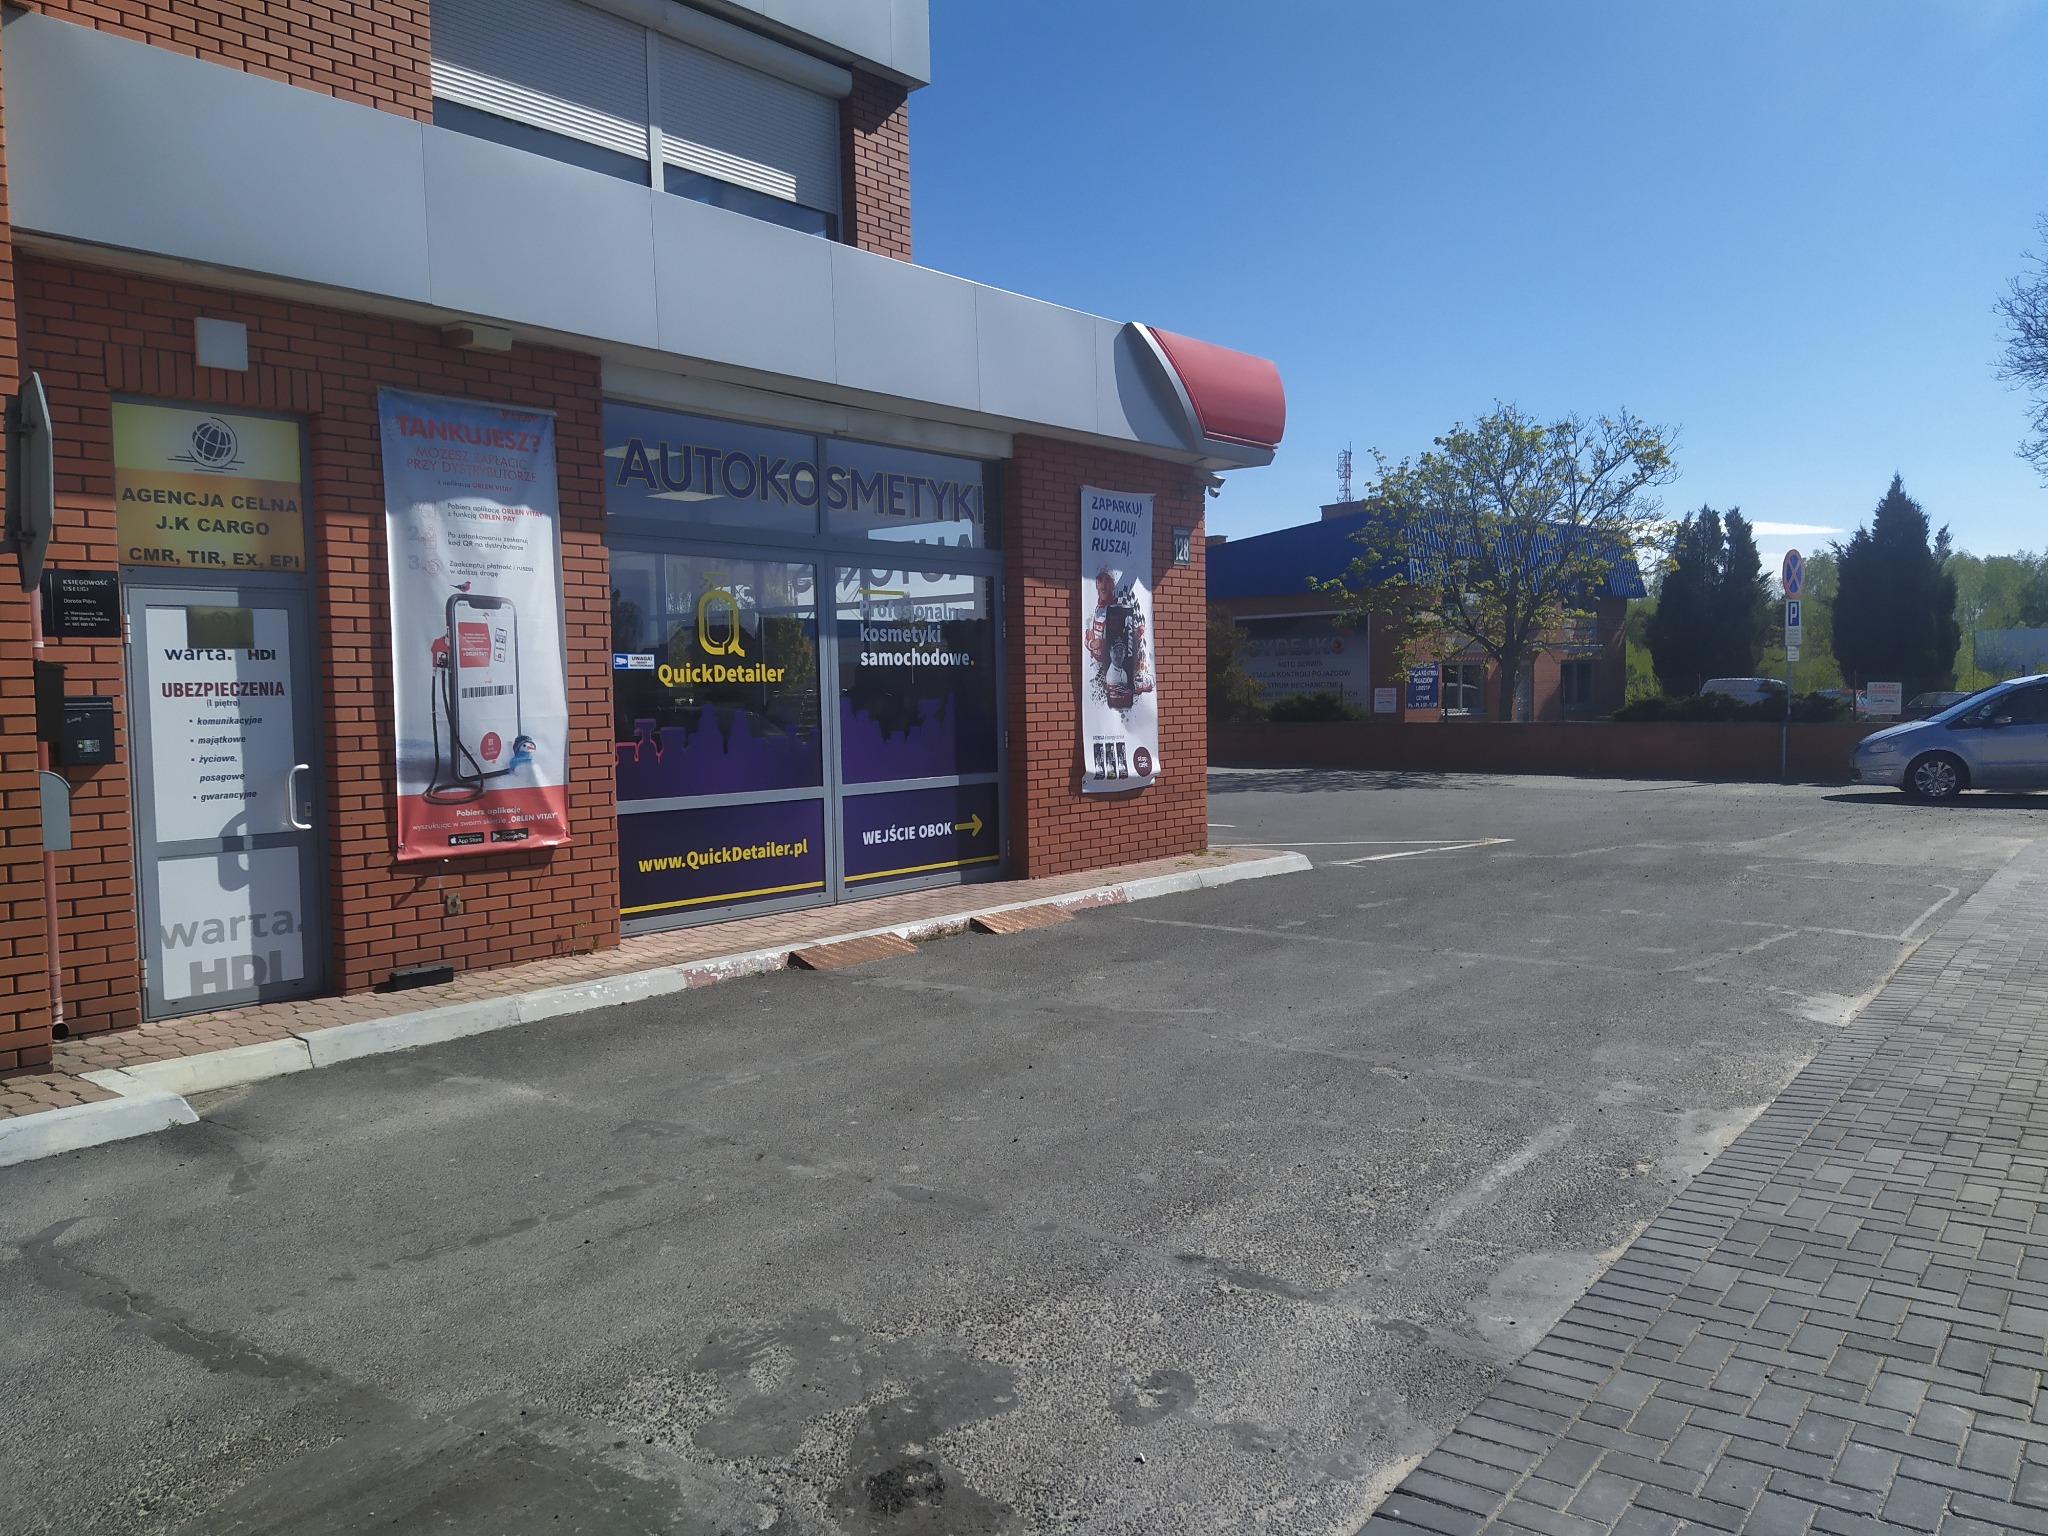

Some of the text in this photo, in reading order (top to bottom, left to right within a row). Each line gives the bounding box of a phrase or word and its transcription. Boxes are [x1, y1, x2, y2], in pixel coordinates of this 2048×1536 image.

[397, 415, 541, 454] TANKUJESZ?
[416, 447, 527, 470] MOŻESZ ZAPŁACIĆ
[407, 458, 537, 483] PRZY DYSTRYBUTORZE
[473, 483, 494, 491] ORLEN
[616, 437, 984, 525] AUTOKOSMETYKI
[122, 487, 298, 513] AGENCJA CELNA
[1091, 496, 1144, 518] ZAPARKUJ.
[447, 503, 471, 511] Pobierz
[501, 508, 524, 516] ORLEN
[525, 510, 544, 518] VITAY
[453, 510, 477, 520] funkcją
[479, 513, 501, 521] ORLEN
[156, 516, 270, 536] J.K CARGO
[1091, 516, 1138, 538] DOŁADUJ.
[458, 534, 502, 542] zatankowaniu
[503, 537, 529, 546] zeskanuj
[484, 542, 524, 551] dystrybutorze
[1091, 537, 1132, 557] RUSZAJ.
[1174, 537, 1189, 561] 128
[129, 547, 299, 568] CMR, TIR, EX, EPI
[449, 560, 485, 570] Zaakceptuj
[486, 562, 512, 571] płatność
[517, 566, 534, 574] ruszaj
[457, 569, 478, 577] dalszą
[480, 569, 499, 578] drogę
[62, 579, 109, 587] KSIĘGOWOŚĆ
[1790, 602, 1798, 624] P
[860, 623, 942, 645] kosmetyki
[247, 649, 276, 661] HDI
[860, 647, 976, 668] samochodowe.
[1277, 660, 1296, 668] AUTO
[657, 663, 785, 688] QuickDetailer
[1277, 670, 1311, 678] KONTROLI
[1312, 669, 1351, 678] POJAZDÓW
[162, 681, 285, 698] UBEZPIECZENIA
[1291, 681, 1339, 689] MECHANICZNE
[214, 699, 241, 709] piętro)
[197, 715, 263, 726] komunikacyjne
[198, 736, 247, 746] majątkowe
[199, 755, 238, 765] życiowe,
[199, 773, 246, 784] posagowe
[201, 791, 258, 803] gwarancyjne
[456, 806, 521, 817] Pobierz aplikację
[412, 823, 451, 832] wyszukując
[460, 819, 482, 827] swoim
[483, 817, 506, 825] sklepie
[862, 821, 953, 846] WEJŚCIE OBOK
[638, 838, 809, 873] www.QuickDetailer.pl
[189, 950, 283, 996] HDI
